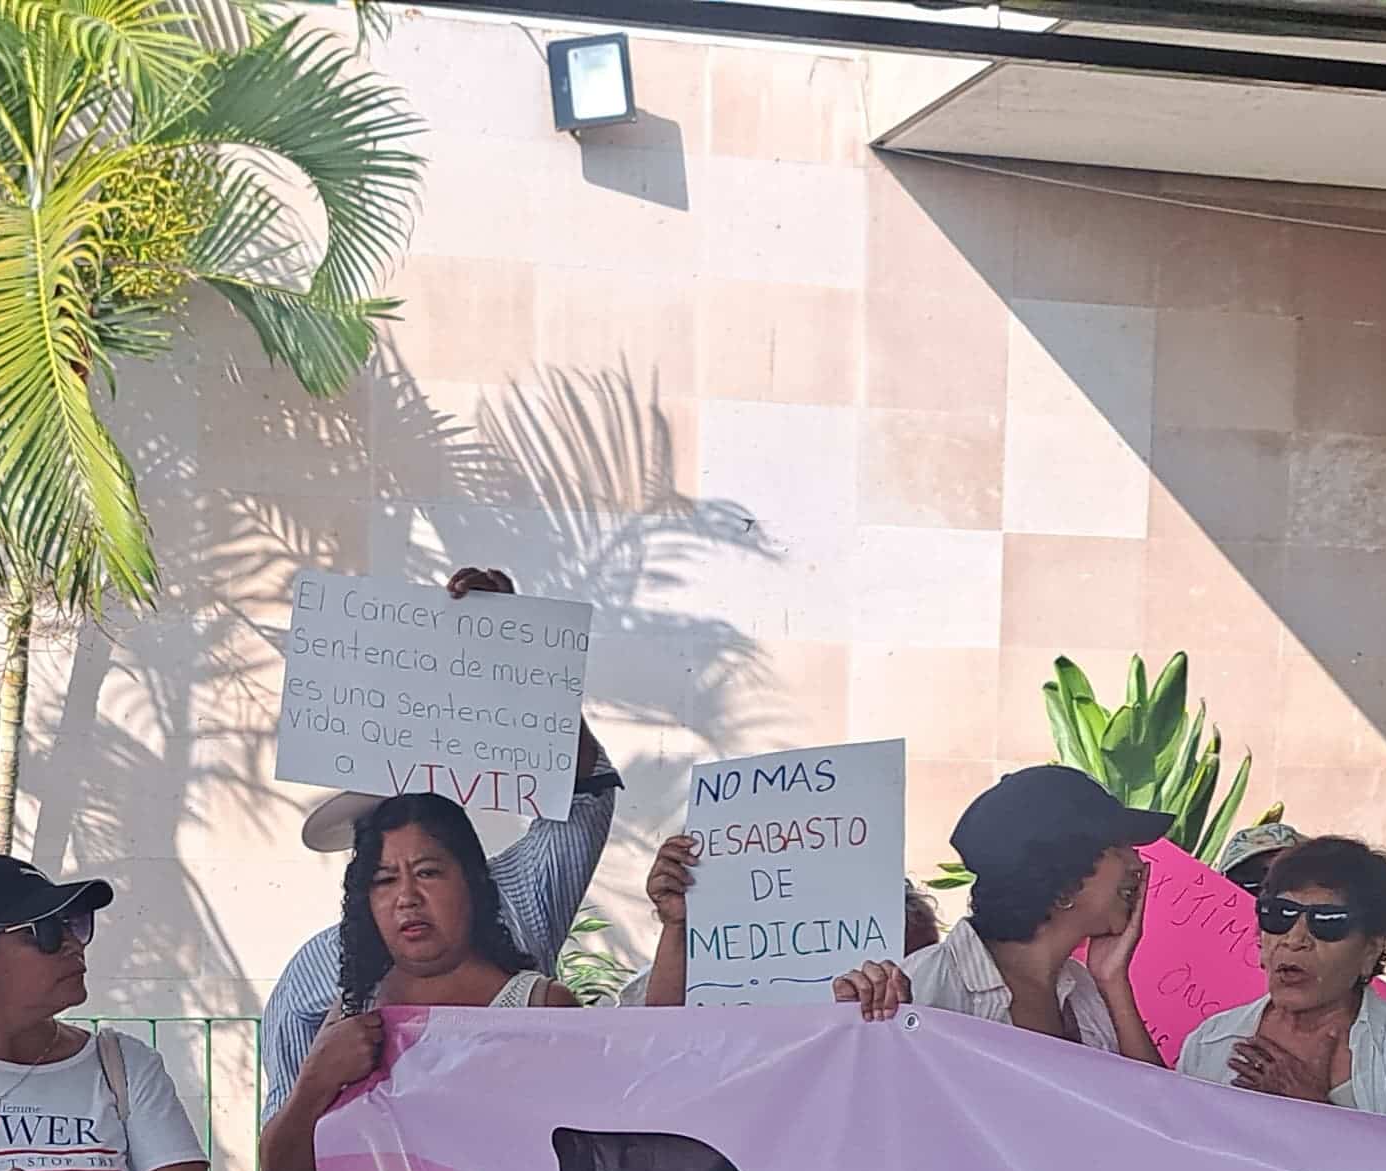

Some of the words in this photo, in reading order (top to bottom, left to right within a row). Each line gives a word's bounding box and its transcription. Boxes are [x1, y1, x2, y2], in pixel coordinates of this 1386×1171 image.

[298, 581, 326, 612] El
[457, 613, 493, 639] no
[500, 619, 534, 644] es
[543, 624, 589, 653] una
[450, 648, 485, 679] de
[492, 661, 583, 697] muerte
[288, 677, 322, 702] es
[333, 685, 385, 709] una
[544, 711, 576, 736] de
[430, 728, 462, 755] te
[387, 759, 542, 819] VIVIR
[696, 770, 742, 806] NO
[752, 758, 836, 794] MAS
[688, 816, 868, 860] DESABASTO
[750, 868, 794, 902] DE
[689, 915, 888, 961] MEDICINA
[26, 1156, 74, 1168] STOP
